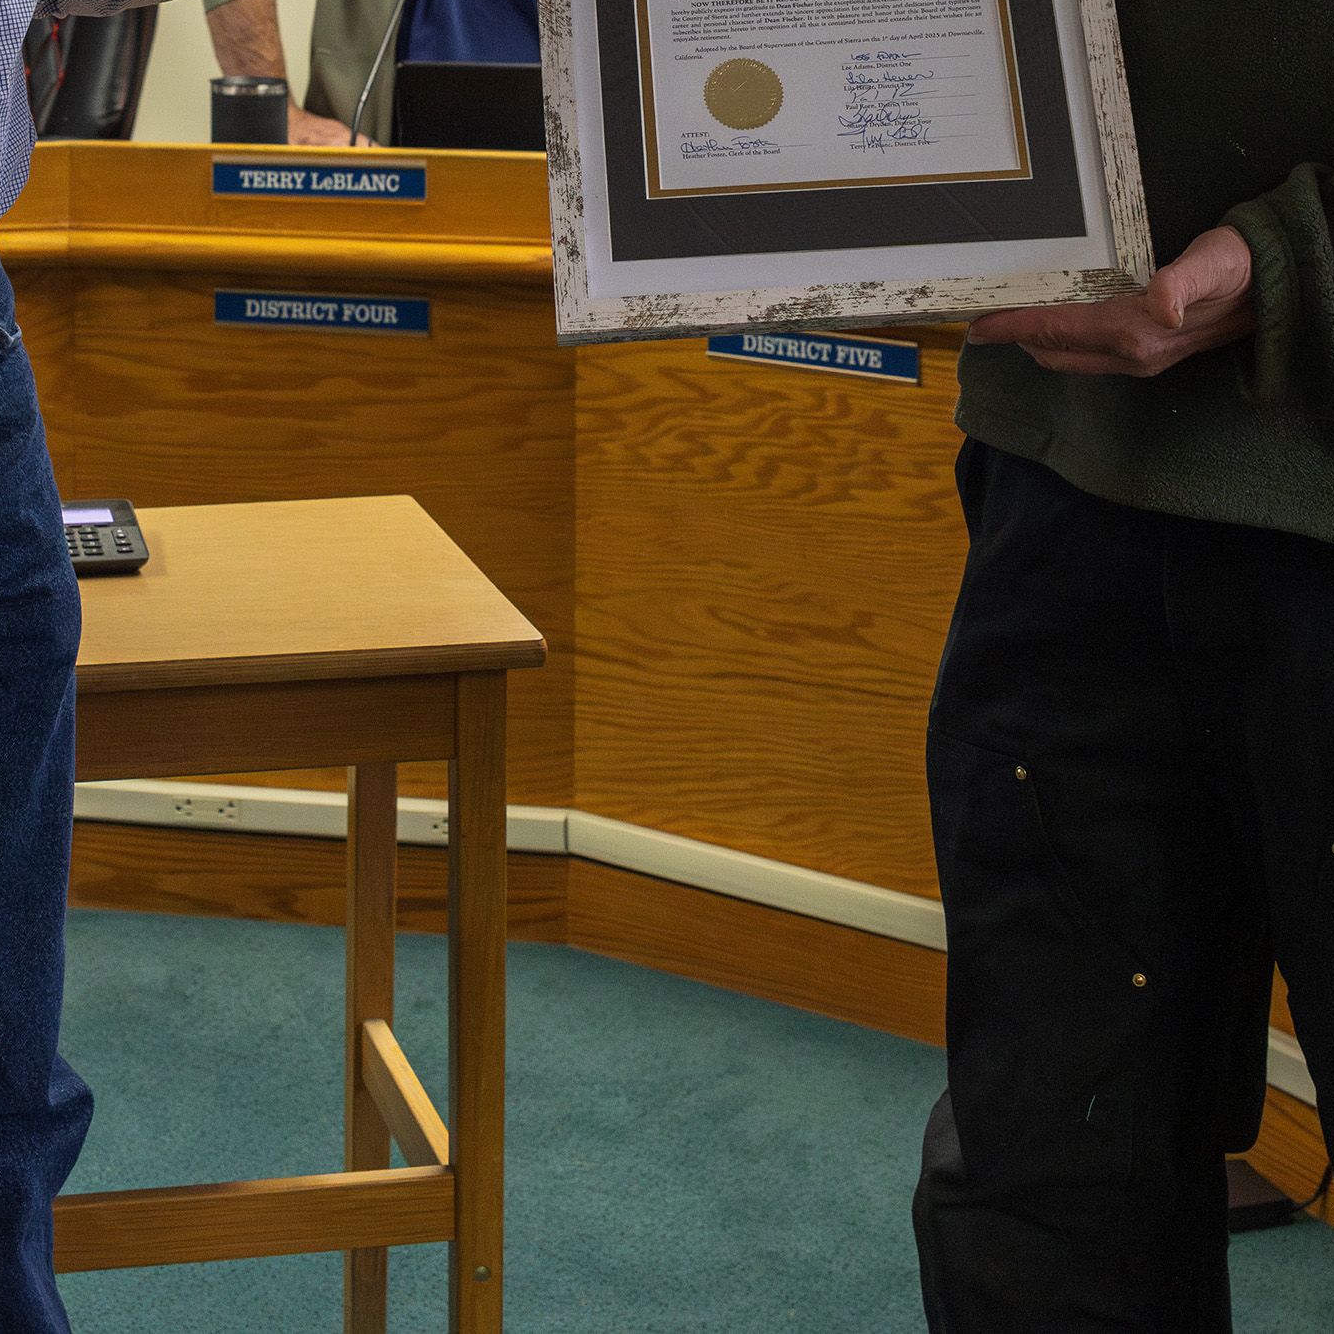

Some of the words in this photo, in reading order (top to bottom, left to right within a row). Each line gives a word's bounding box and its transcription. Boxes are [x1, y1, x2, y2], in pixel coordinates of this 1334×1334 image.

[239, 170, 306, 190] TERRY
[310, 172, 400, 192] LeBLANC
[245, 298, 338, 321] DISTRICT
[342, 303, 399, 325] FOUR
[742, 334, 833, 362] DISTRICT
[835, 345, 883, 368] FIVE
